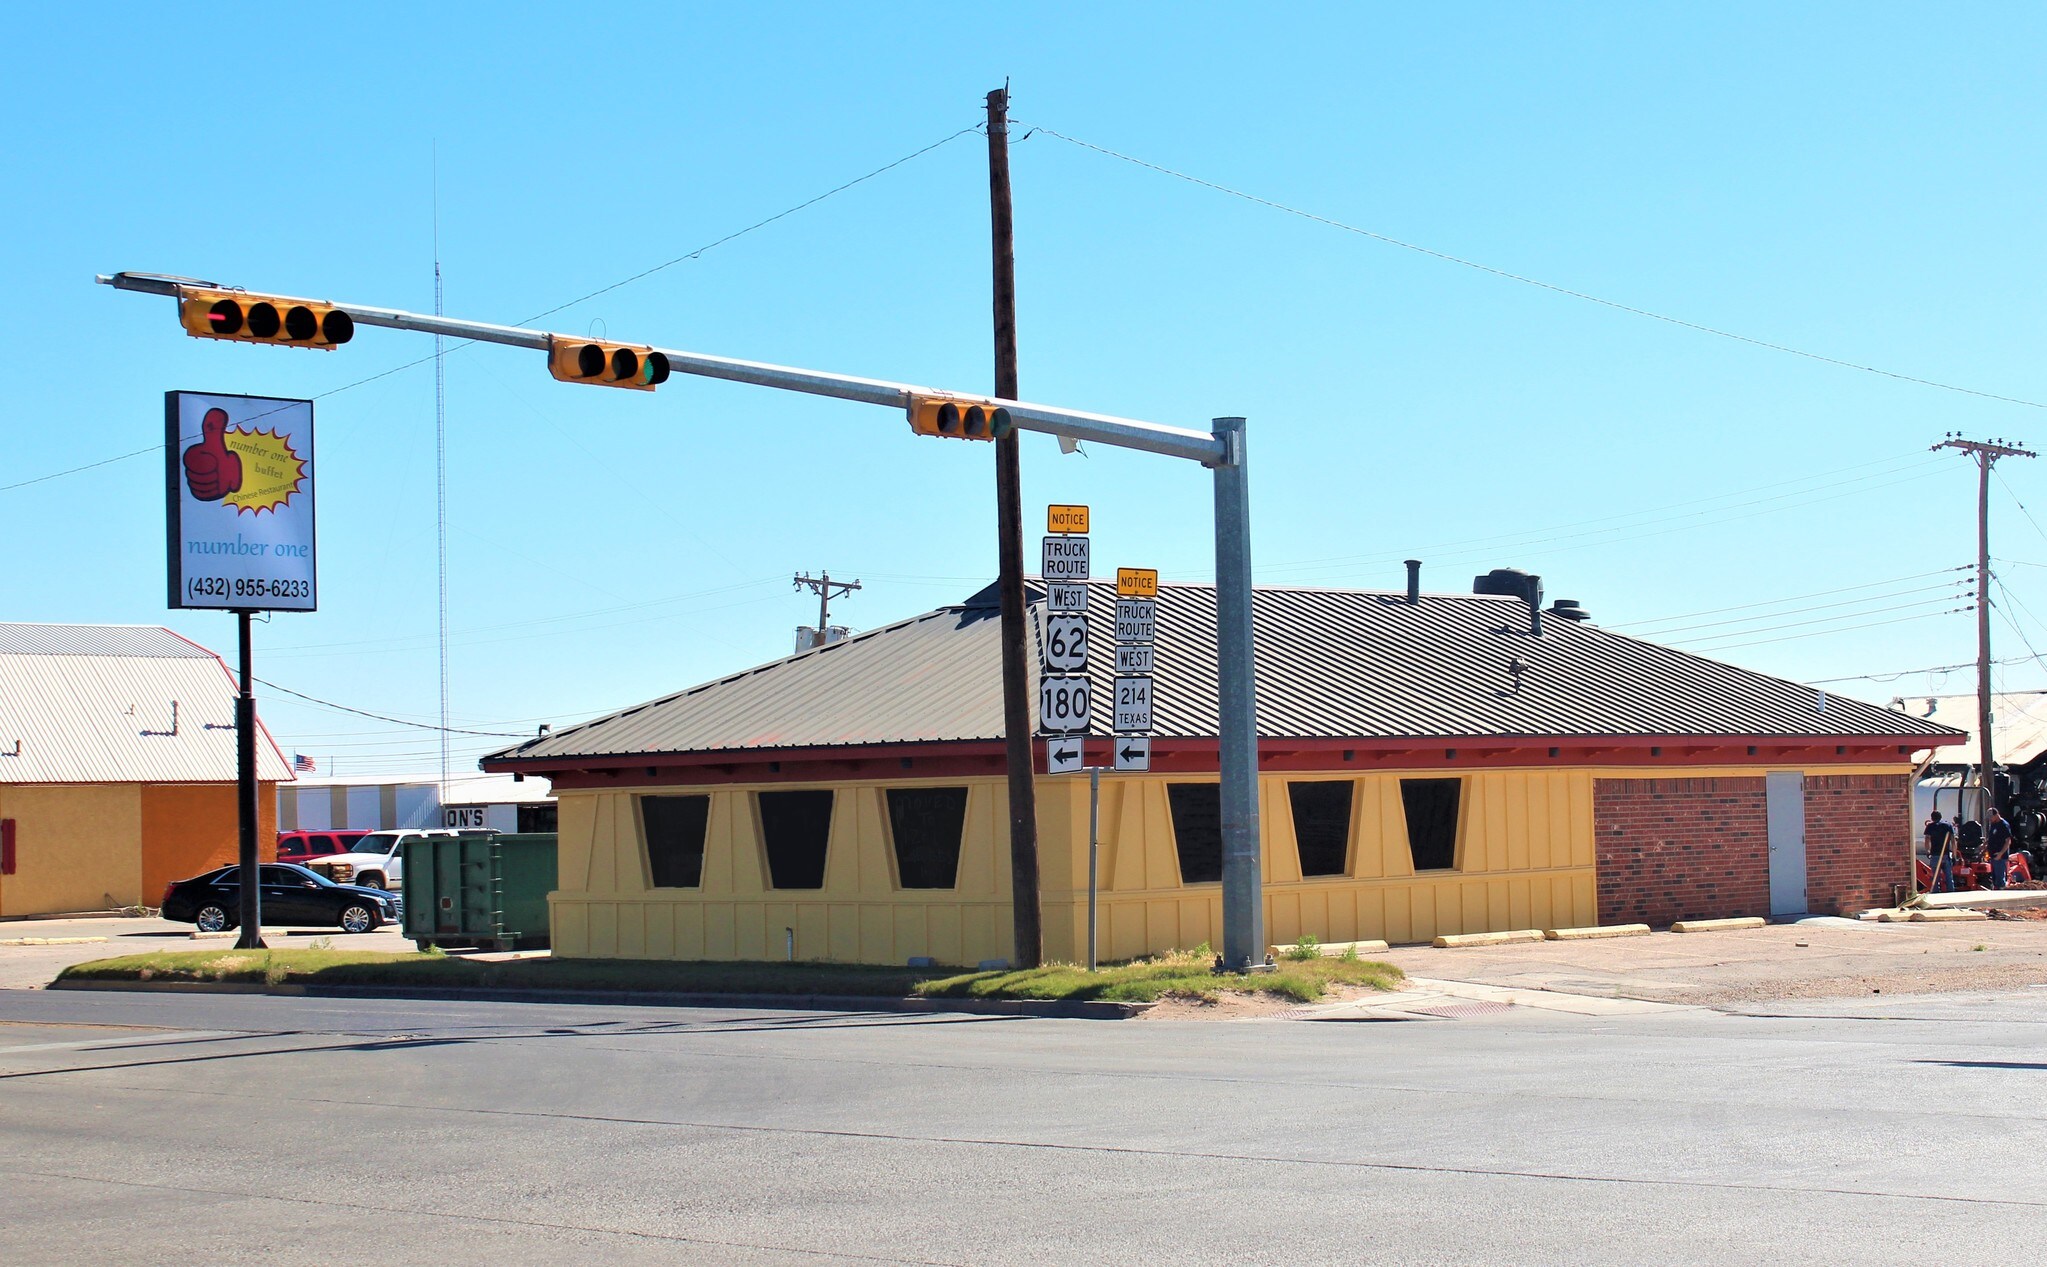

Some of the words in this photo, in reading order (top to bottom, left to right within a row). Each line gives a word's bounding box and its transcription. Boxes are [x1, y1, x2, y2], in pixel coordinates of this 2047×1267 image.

[229, 440, 269, 457] number
[270, 452, 289, 463] one
[254, 462, 284, 479] buffet
[232, 491, 258, 502] Chinese
[258, 482, 294, 496] Restaurant
[1052, 513, 1084, 525] NOTICE
[187, 533, 269, 556] number
[274, 543, 308, 558] one
[1046, 542, 1086, 557] TRUCK
[1047, 560, 1087, 574] ROUTE
[188, 577, 231, 600] (432)
[235, 578, 310, 598] 955-6233
[1121, 576, 1153, 589] NOTICE
[1053, 588, 1082, 607] WEST
[1118, 605, 1152, 619] TRUCK
[1118, 622, 1152, 636] ROUTE
[1051, 627, 1084, 658] 62
[1120, 651, 1149, 667] WEST
[1045, 687, 1087, 719] 180
[1120, 687, 1146, 705] 214
[1119, 713, 1148, 724] TEXAS
